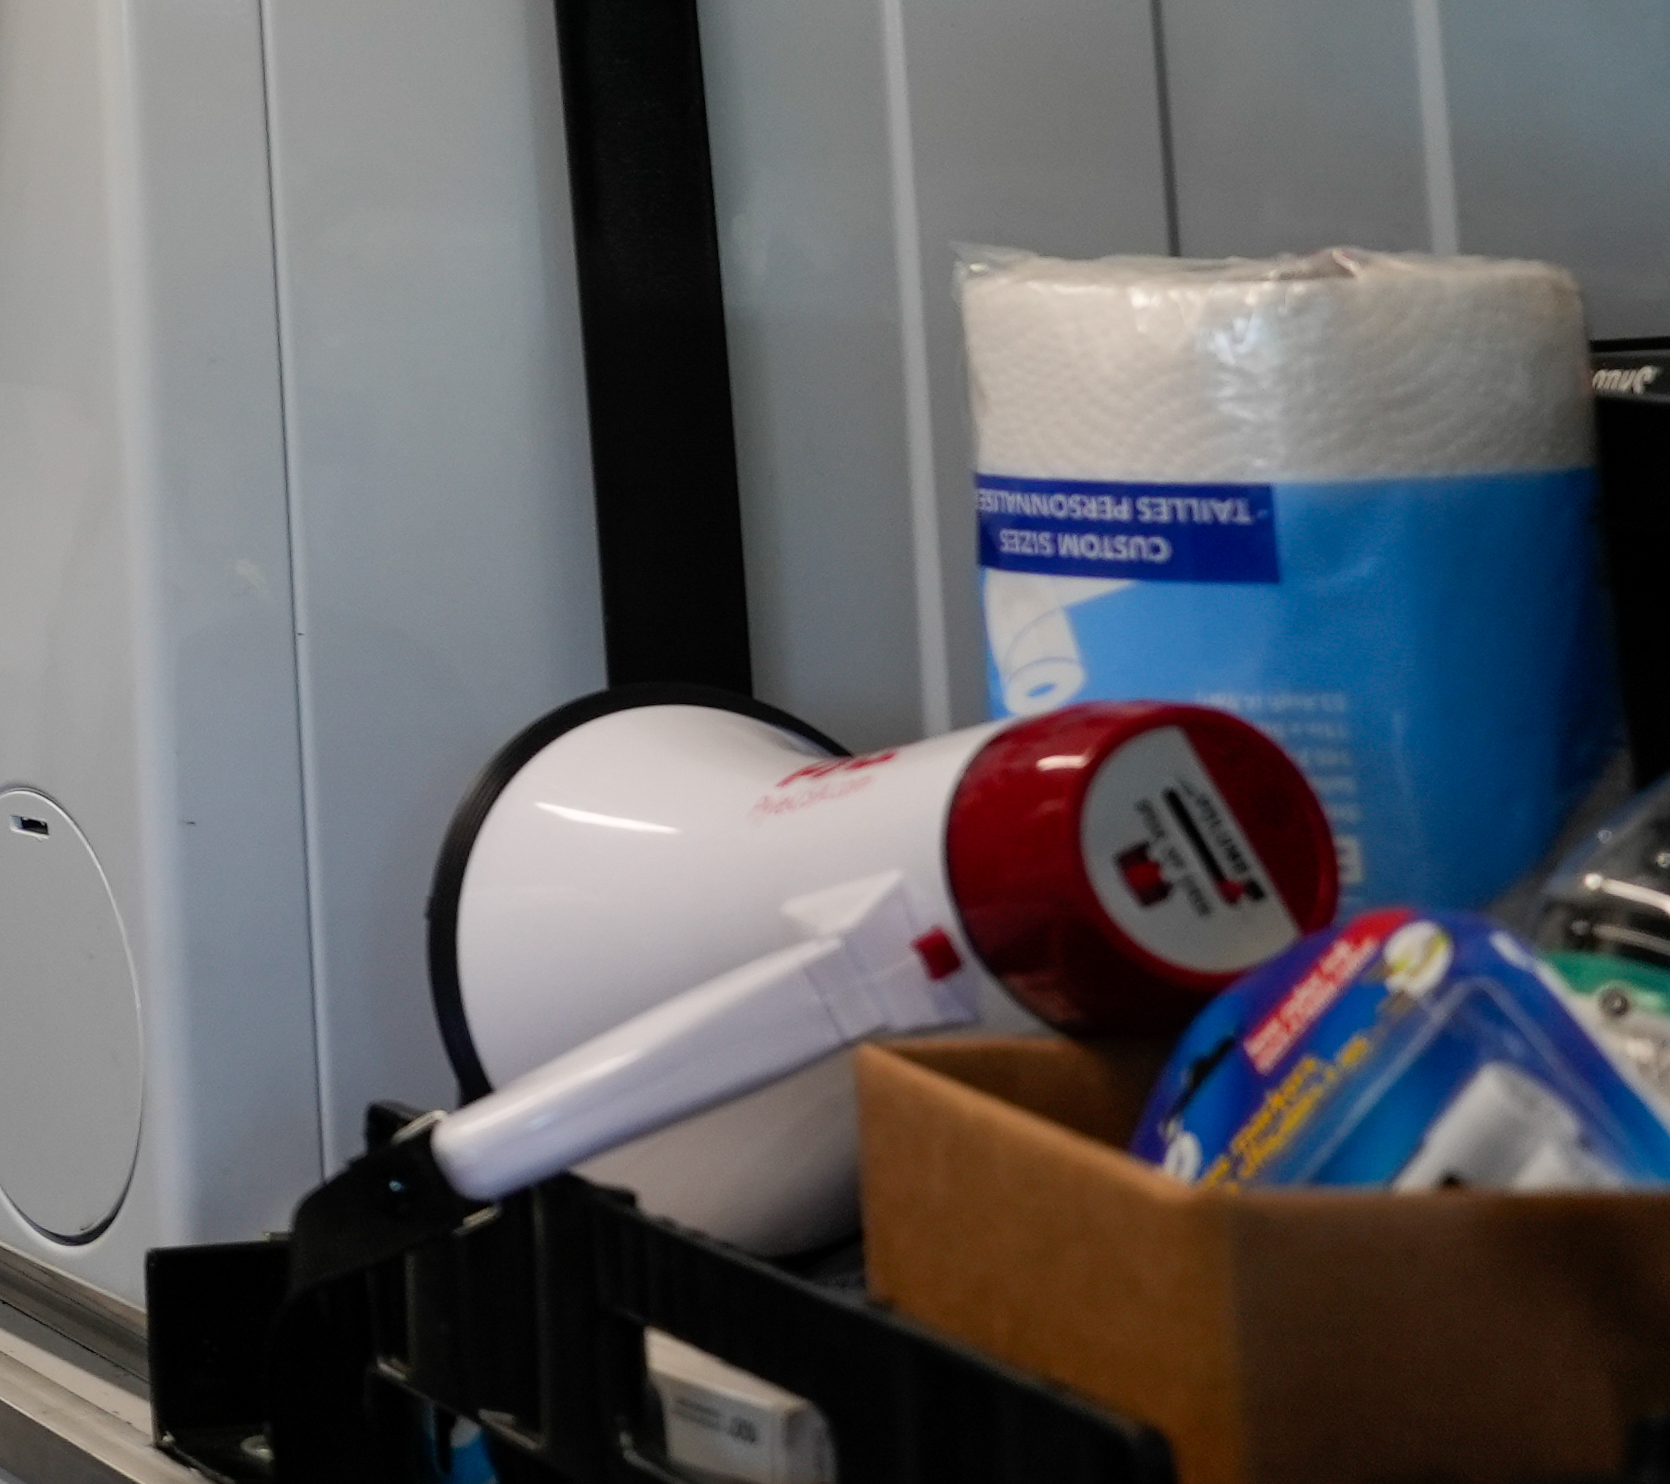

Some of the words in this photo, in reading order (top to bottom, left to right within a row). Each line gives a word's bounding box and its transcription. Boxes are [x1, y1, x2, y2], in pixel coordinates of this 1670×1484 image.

[1138, 495, 1253, 525] TAILLES
[999, 528, 1059, 558] SIZES
[1059, 531, 1172, 564] CUSTOM
